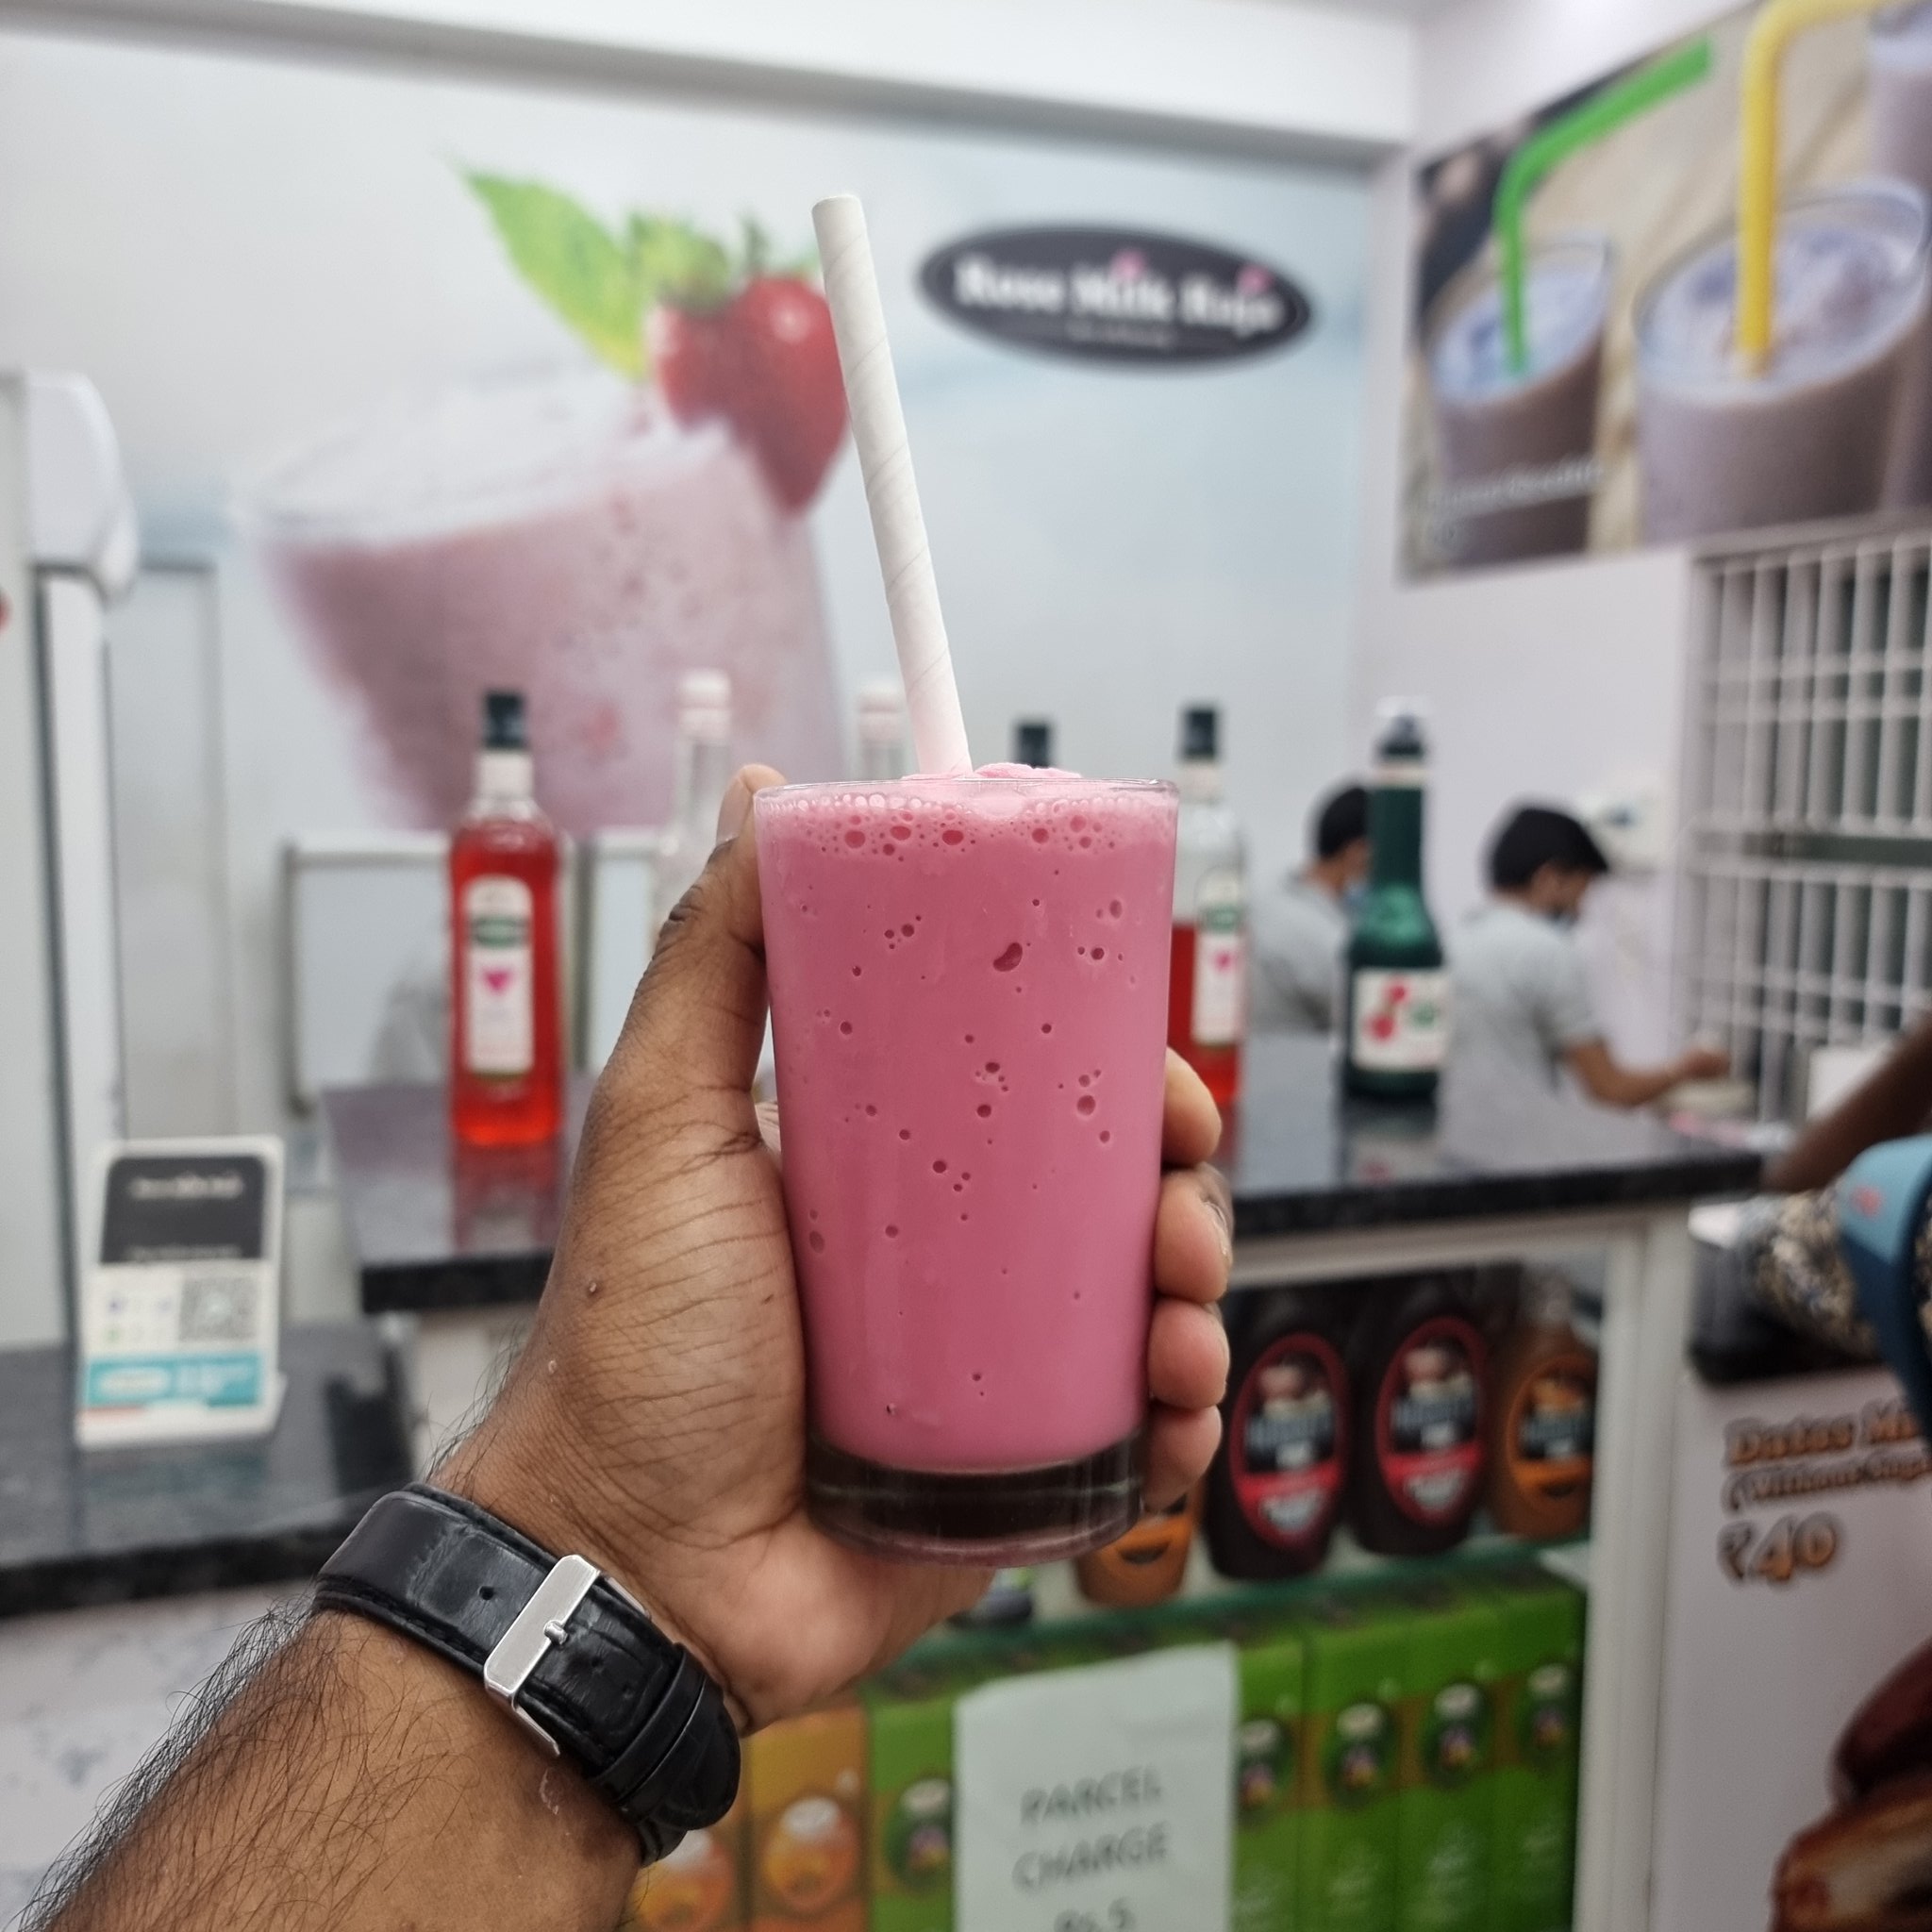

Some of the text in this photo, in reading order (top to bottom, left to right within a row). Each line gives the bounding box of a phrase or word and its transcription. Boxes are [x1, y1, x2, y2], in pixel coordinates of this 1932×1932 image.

[955, 255, 1064, 314] Rose
[1070, 249, 1174, 322] Milk
[1723, 1414, 1855, 1468] Dates
[1019, 1766, 1163, 1827] PARCEL
[1011, 1821, 1169, 1896] CHARGE
